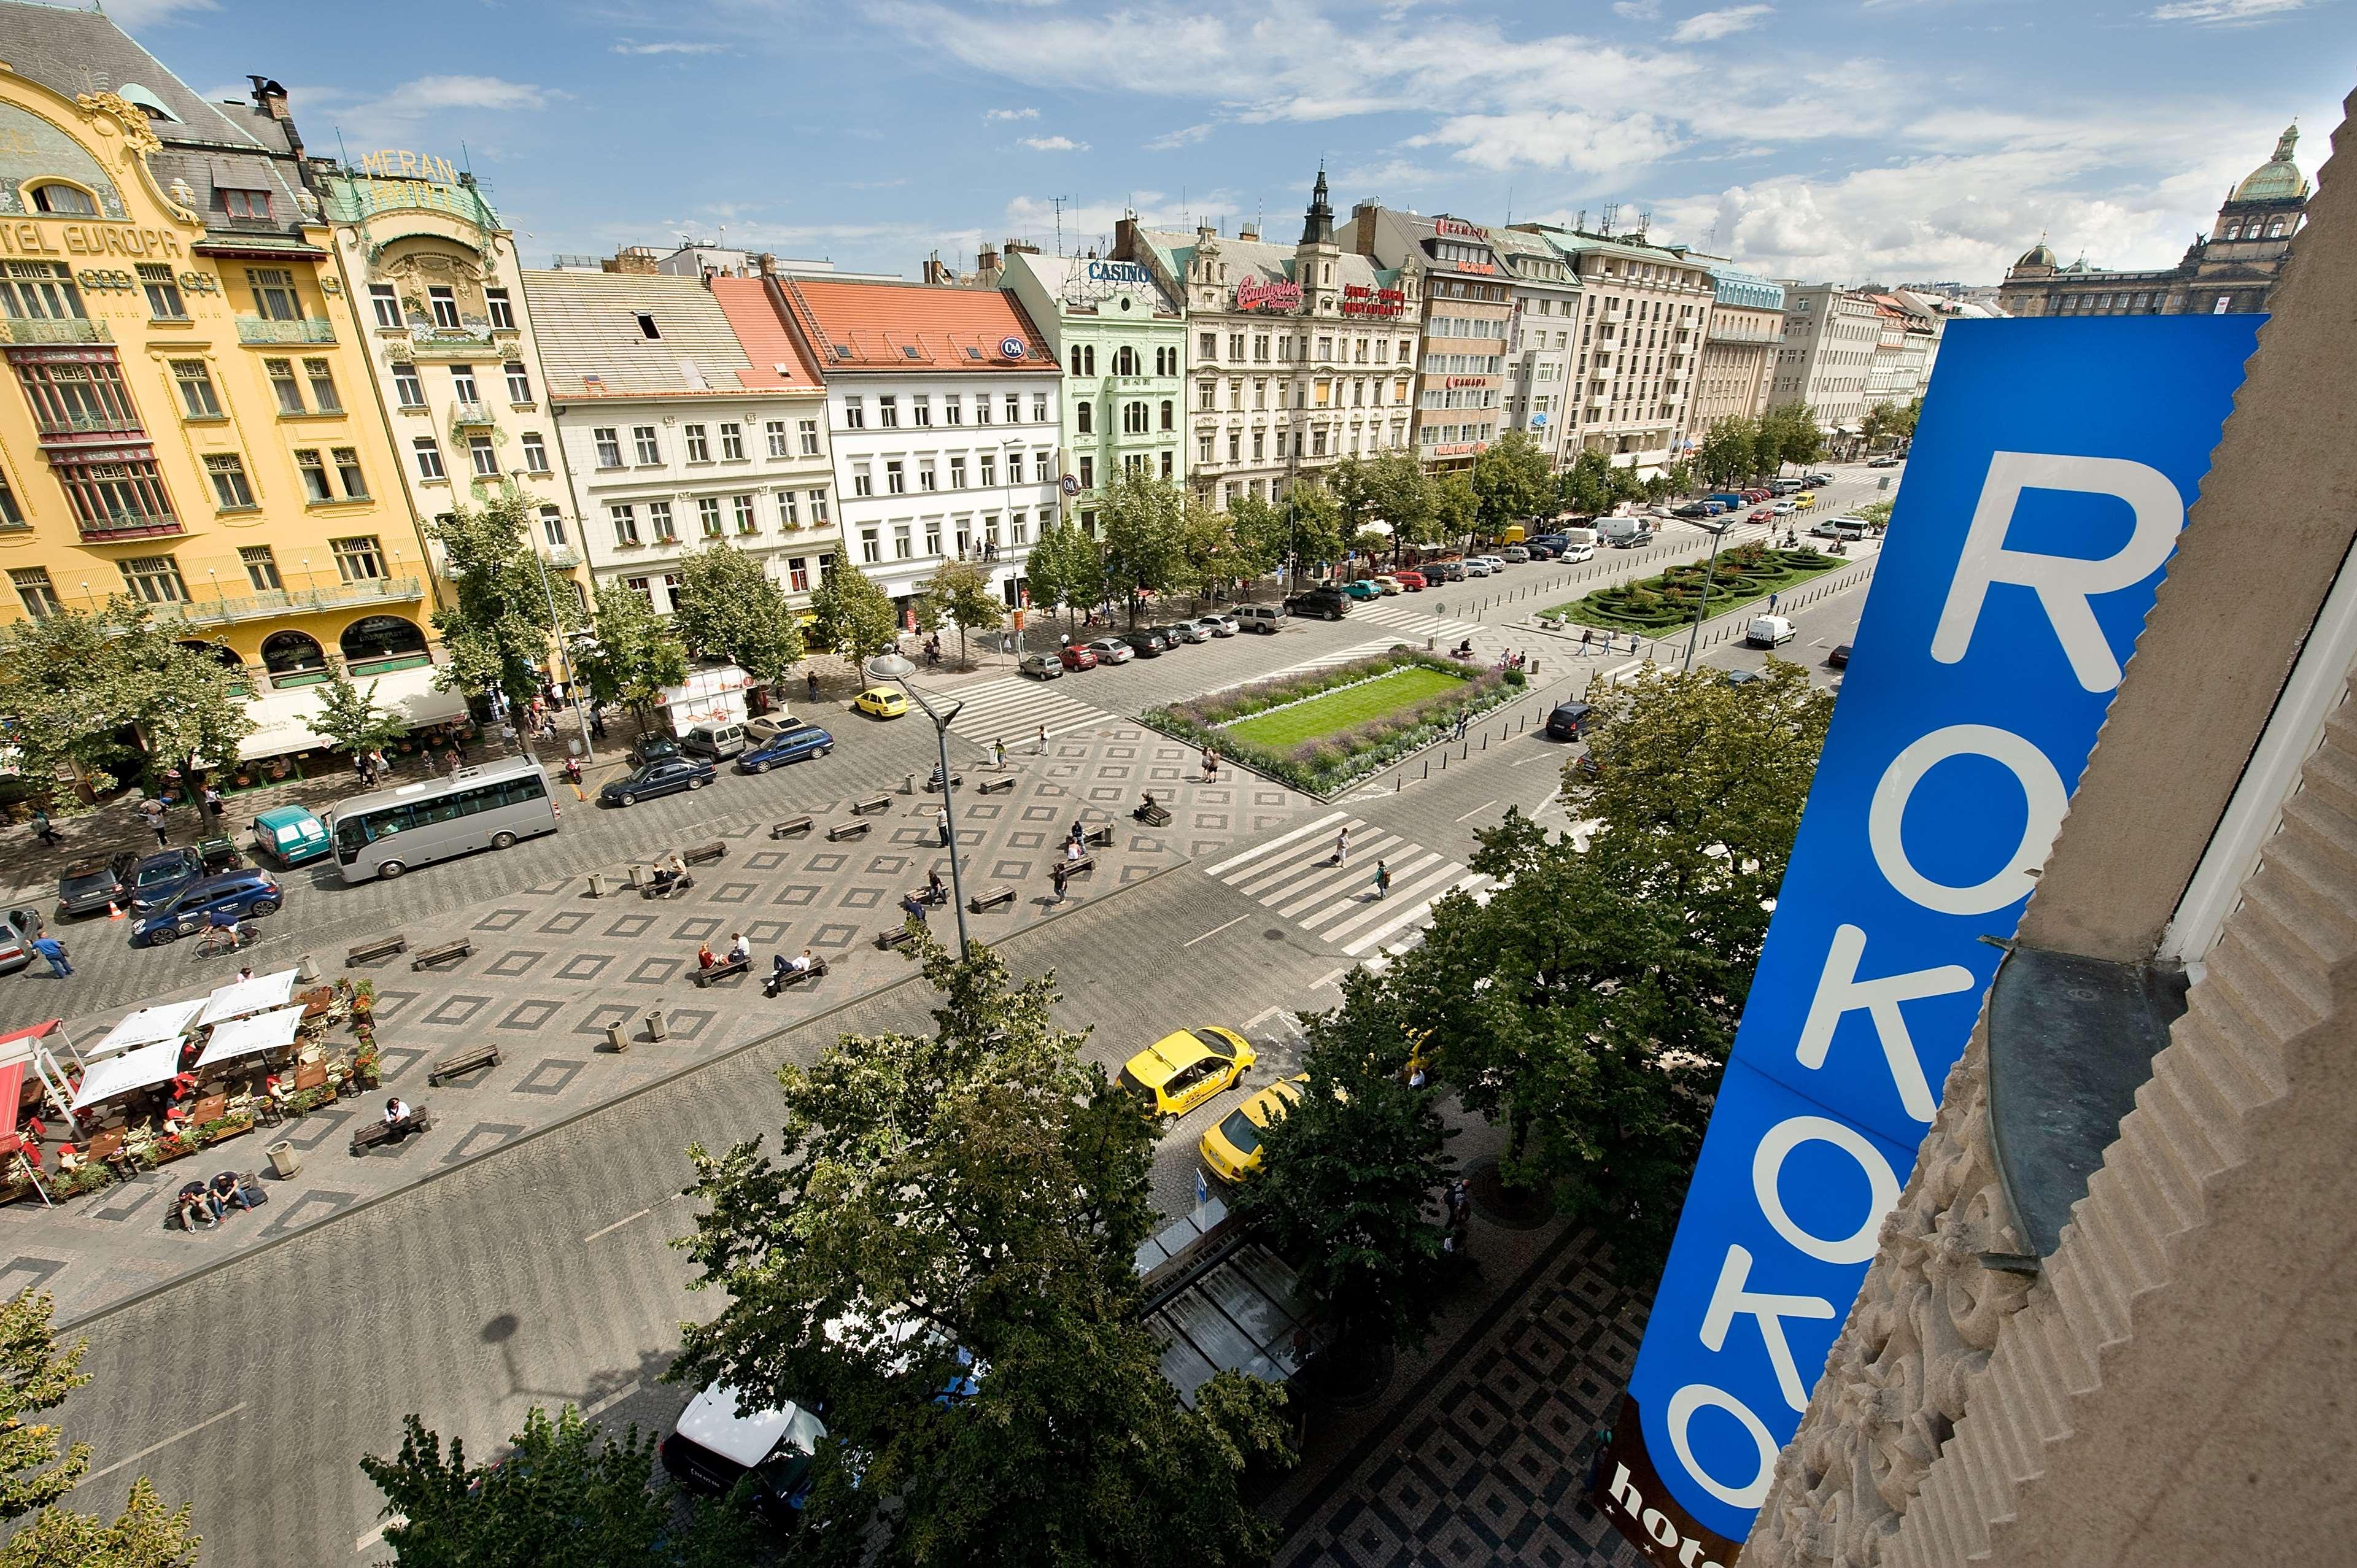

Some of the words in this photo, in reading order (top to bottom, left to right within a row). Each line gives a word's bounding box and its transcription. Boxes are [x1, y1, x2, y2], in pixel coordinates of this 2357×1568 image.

[361, 149, 457, 186] MERAN
[370, 180, 462, 215] HOTEL
[63, 224, 182, 258] EUROPA
[1448, 223, 1489, 238] RAMADA
[1089, 261, 1150, 283] CASINO
[1237, 274, 1303, 307] Budweiser
[1005, 341, 1022, 353] C&A
[1454, 378, 1487, 388] RAMADA
[1668, 450, 2184, 1509] ROKOKO
